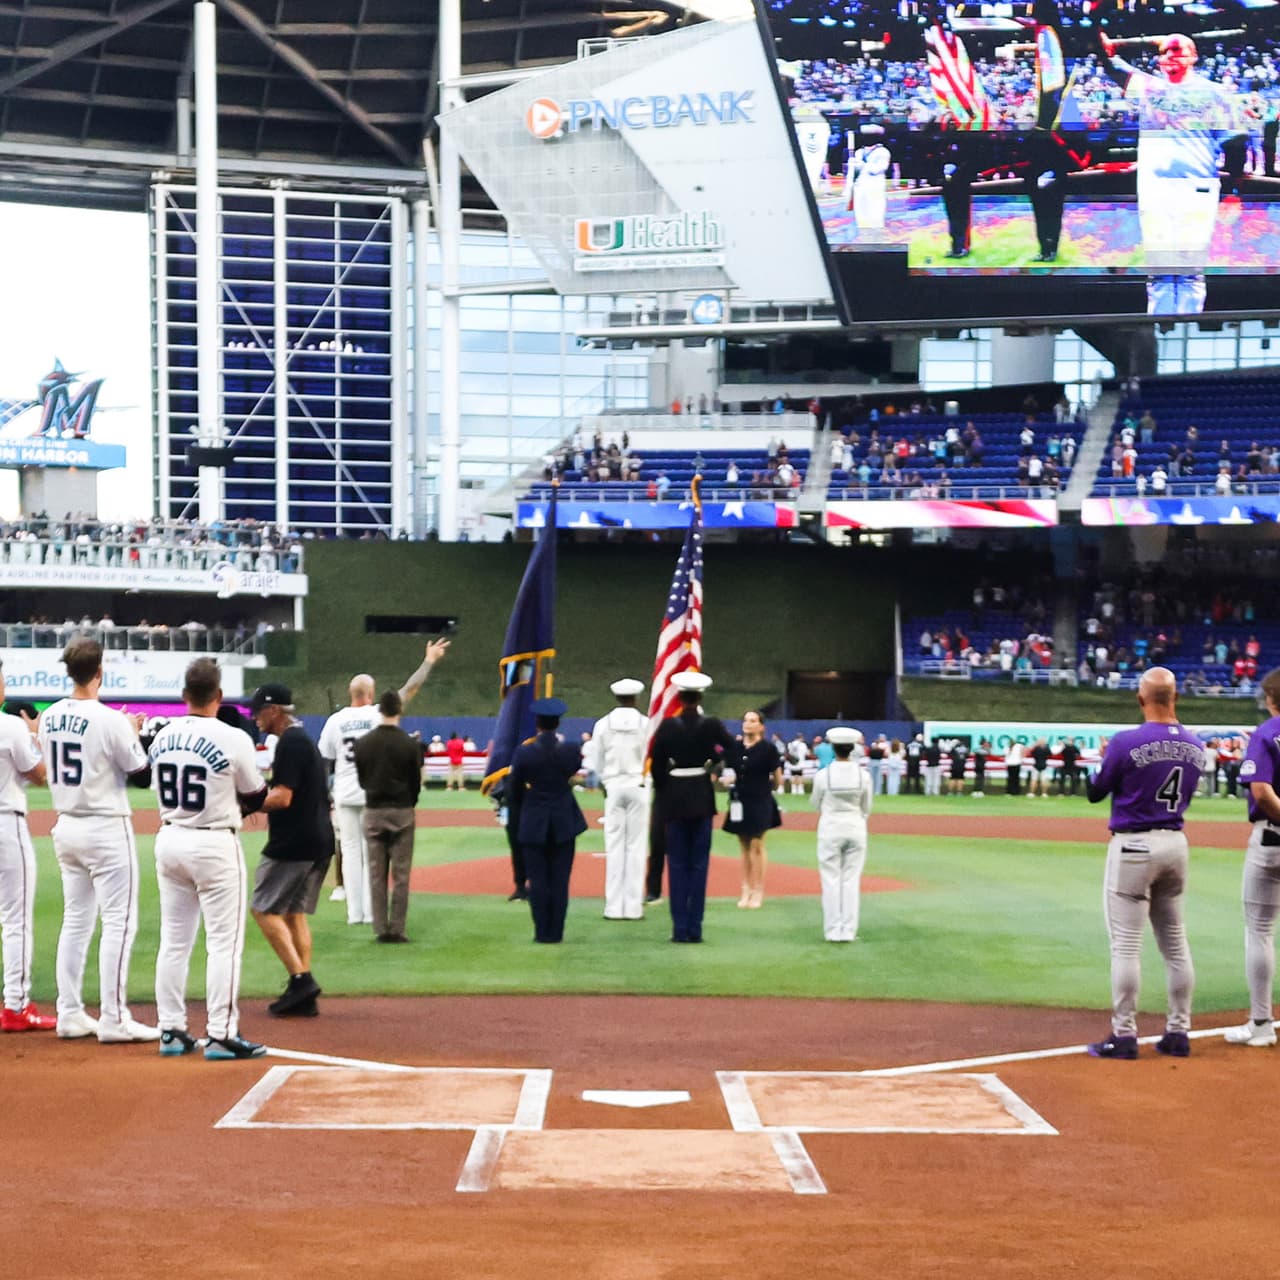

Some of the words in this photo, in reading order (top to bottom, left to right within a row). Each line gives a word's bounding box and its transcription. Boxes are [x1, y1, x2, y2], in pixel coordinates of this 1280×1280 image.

[695, 300, 719, 320] 42
[21, 448, 89, 463] HARBOR
[46, 713, 90, 736] SLATER
[49, 741, 83, 786] 15
[157, 762, 208, 812] 86
[1155, 766, 1184, 813] 4
